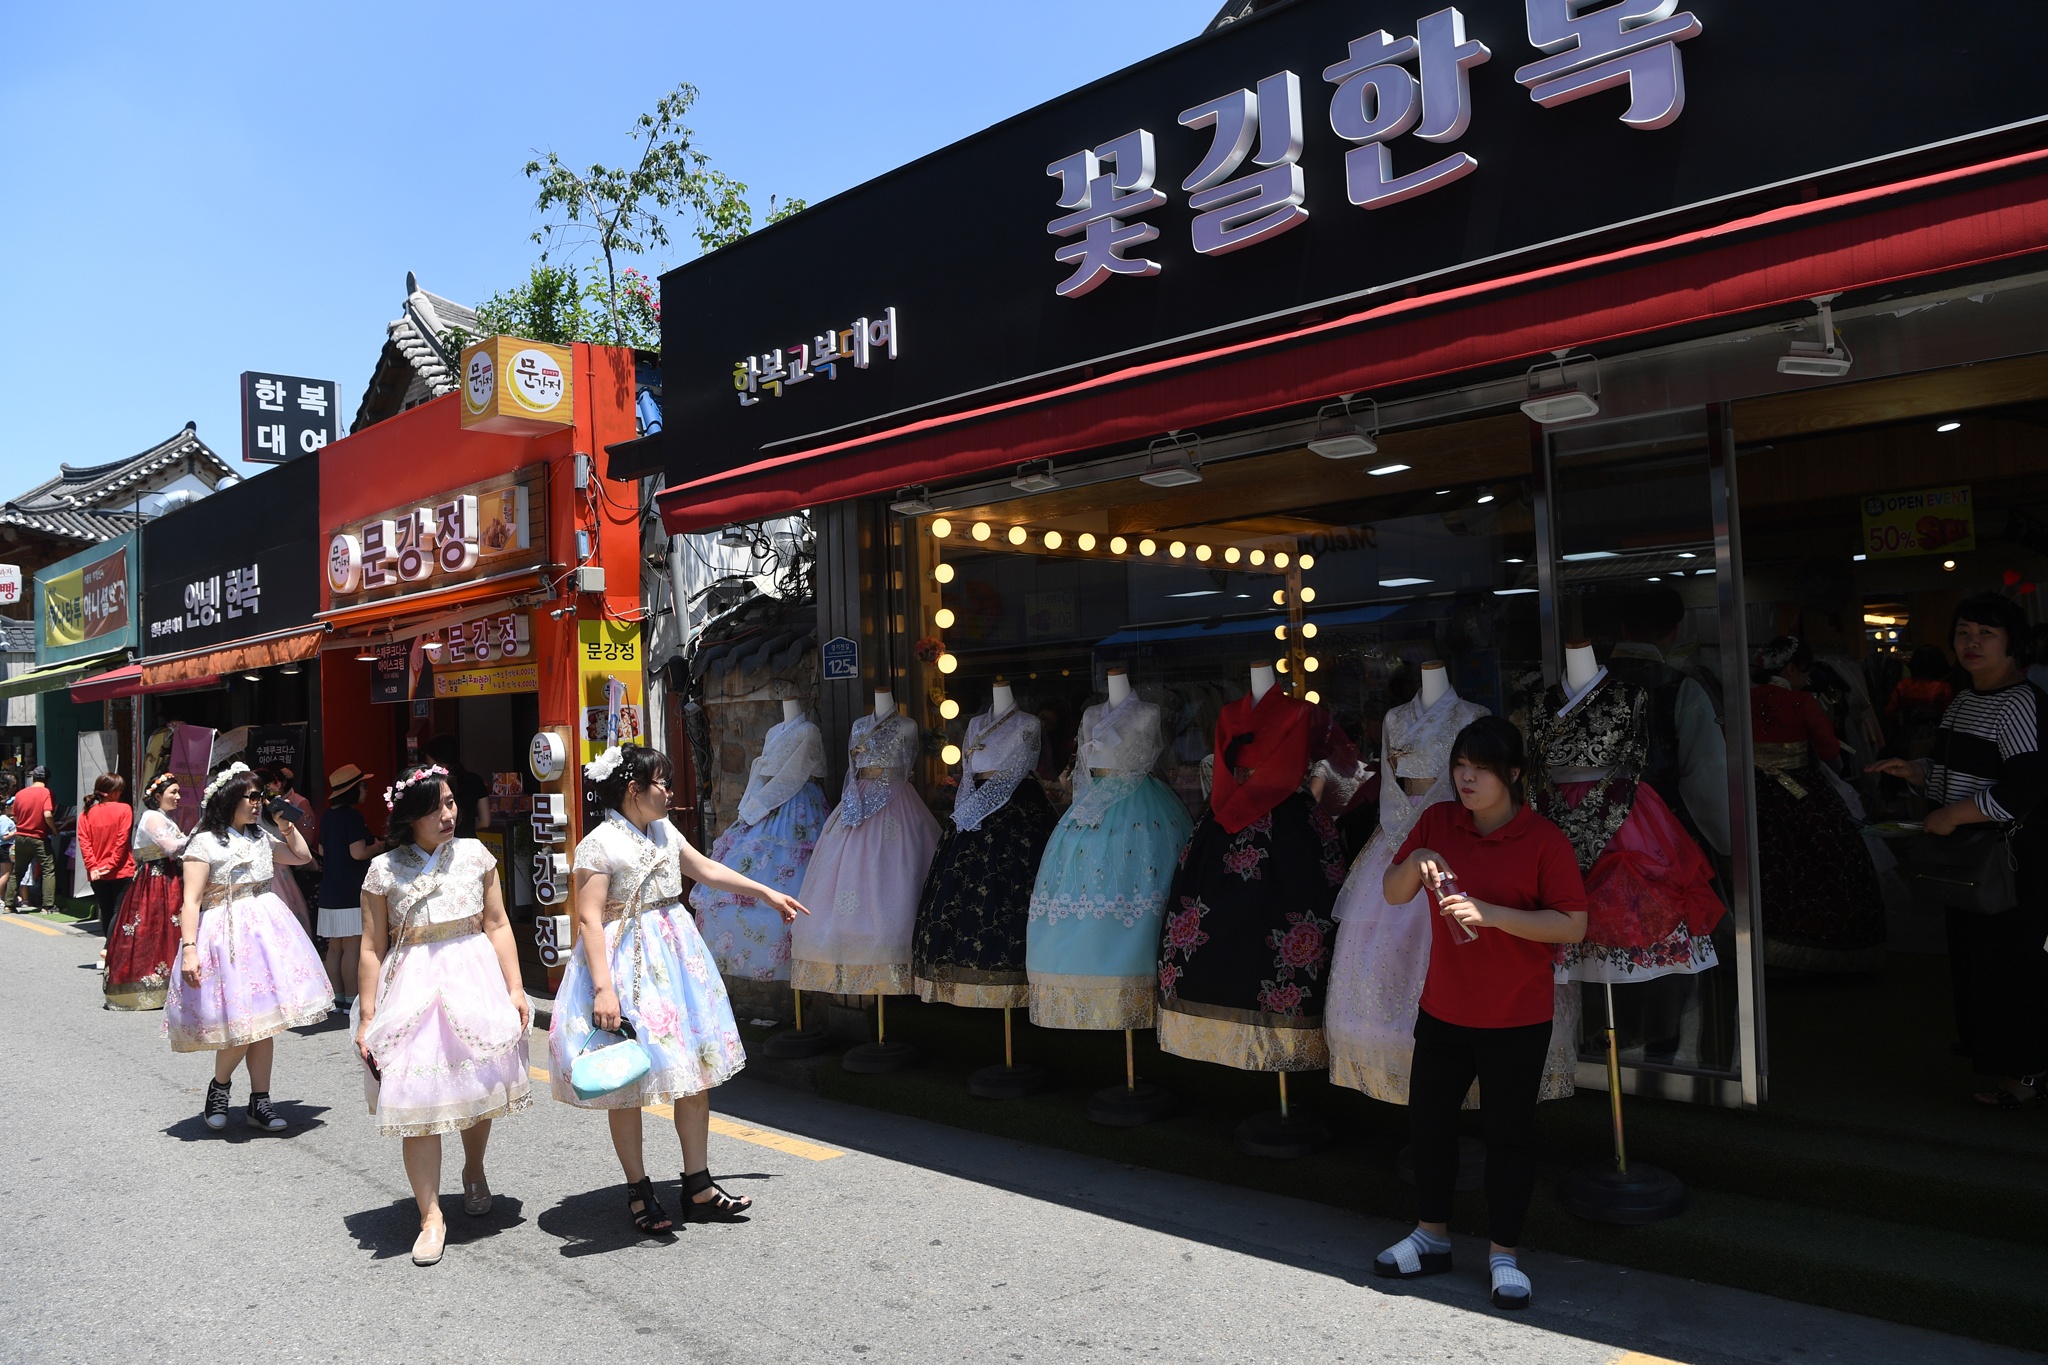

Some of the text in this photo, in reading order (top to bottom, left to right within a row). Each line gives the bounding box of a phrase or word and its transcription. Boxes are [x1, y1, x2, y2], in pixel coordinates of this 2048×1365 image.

[516, 358, 561, 397] 문강정
[1887, 489, 1969, 511] OPEN EVENT
[361, 495, 469, 590] 문강정
[1869, 525, 1916, 553] 50%
[225, 563, 260, 619] 한복
[448, 613, 518, 664] 문강정
[586, 642, 635, 661] 문강정
[377, 657, 405, 672] 아이스크림
[828, 659, 851, 674] 125
[531, 793, 561, 968] 문강정
